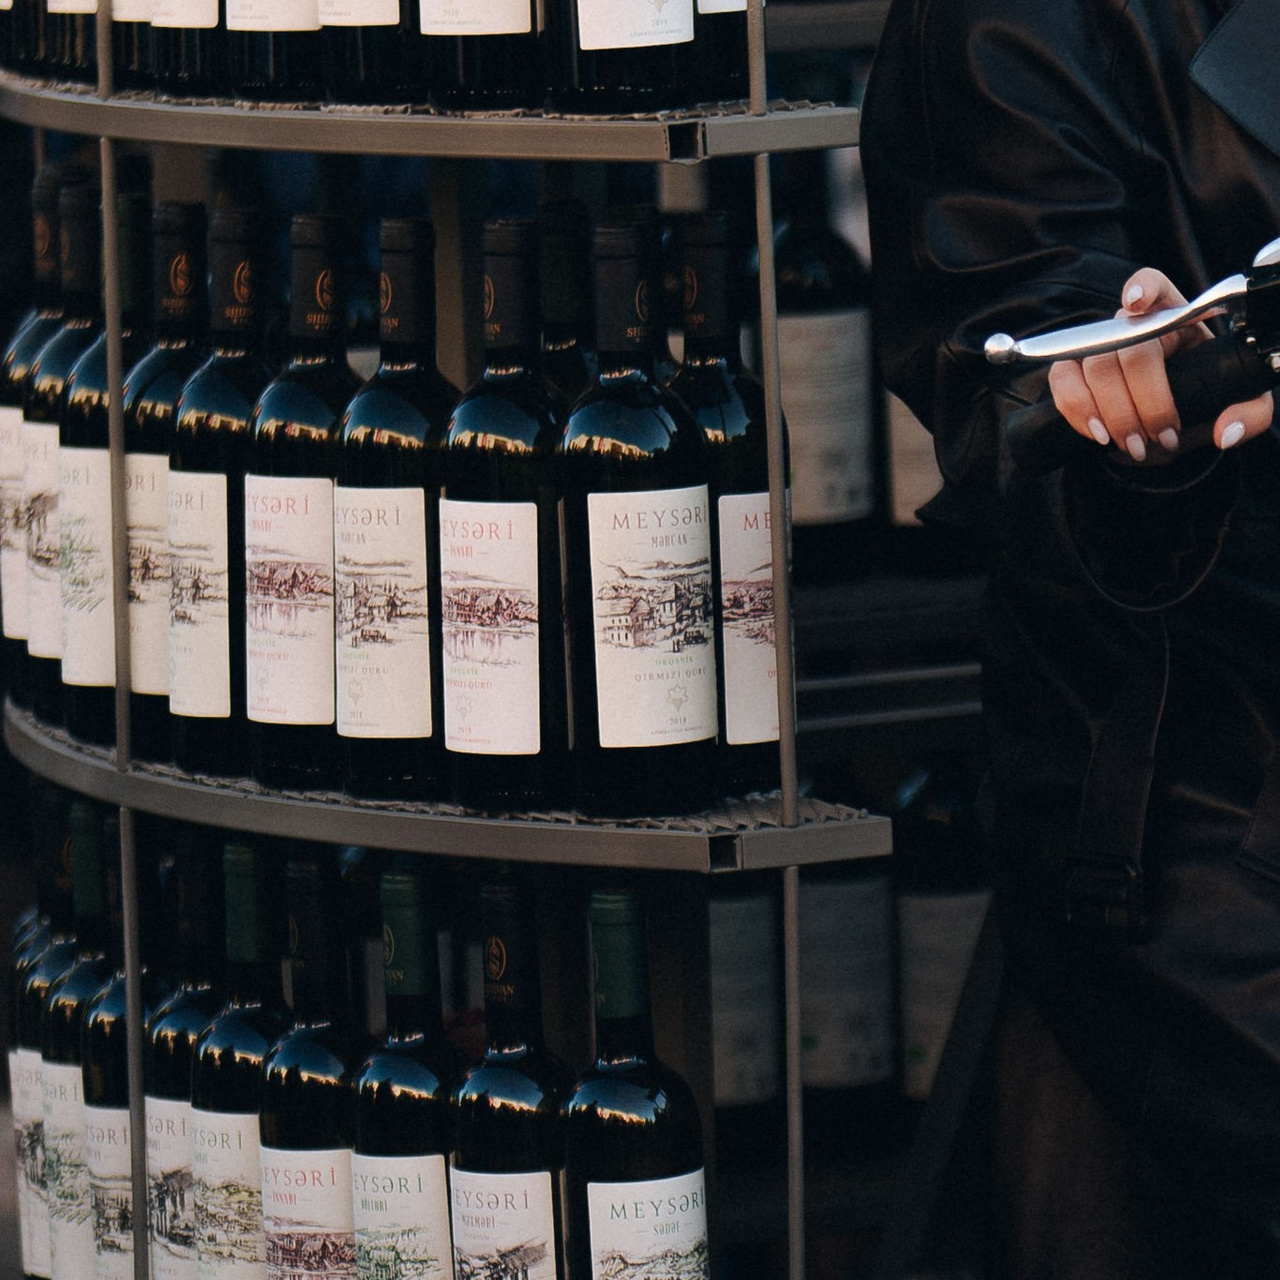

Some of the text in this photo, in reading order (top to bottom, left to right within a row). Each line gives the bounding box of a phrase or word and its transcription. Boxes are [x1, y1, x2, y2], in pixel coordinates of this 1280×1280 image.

[651, 534, 689, 549] MƏRCAN
[654, 655, 694, 668] ORQANİK
[635, 669, 682, 682] QIRMIZI
[653, 1219, 682, 1236] SƏDƏF
